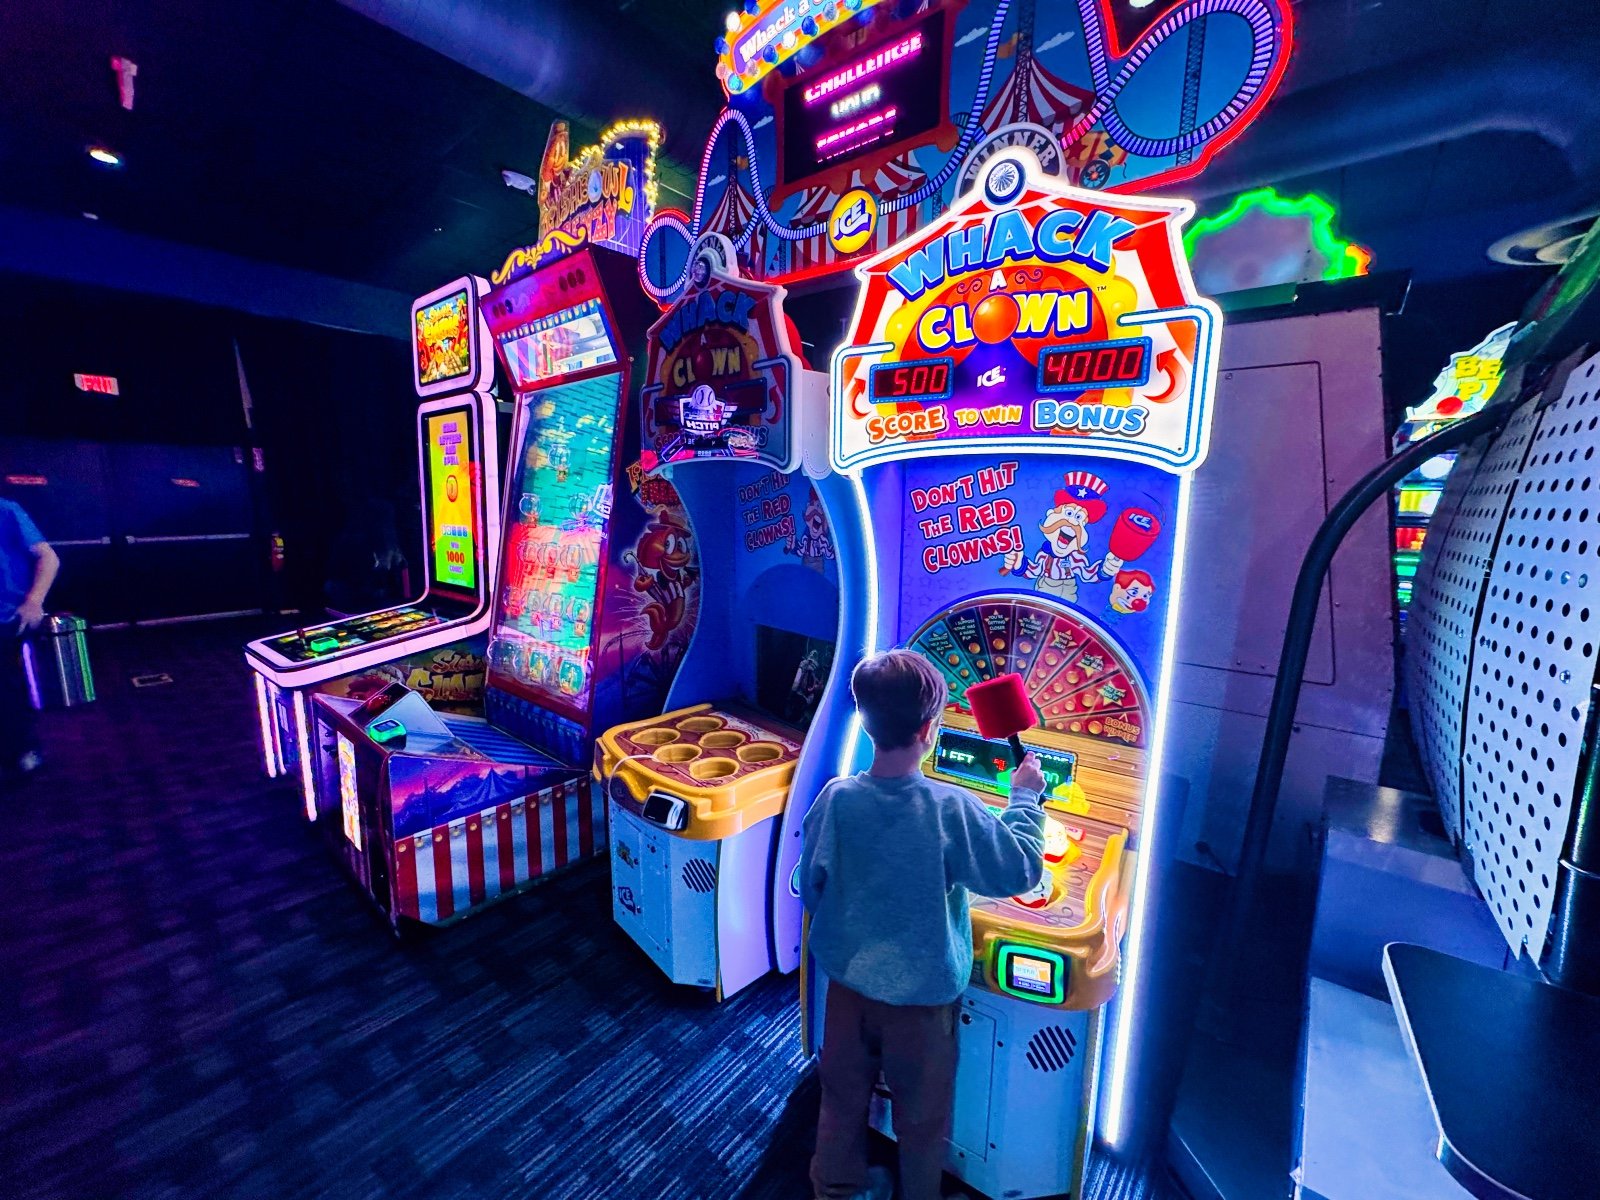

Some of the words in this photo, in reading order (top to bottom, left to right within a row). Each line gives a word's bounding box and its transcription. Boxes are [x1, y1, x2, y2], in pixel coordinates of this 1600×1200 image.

[740, 6, 796, 63] Whack
[966, 131, 1056, 180] WINNER
[834, 199, 870, 239] ICE
[887, 208, 1137, 300] WHACK
[990, 269, 1007, 291] A
[659, 291, 758, 351] WHACK
[918, 289, 1092, 353] CLOWN
[700, 333, 706, 346] A
[893, 364, 949, 396] 500
[977, 365, 1005, 387] ICE
[1048, 347, 1143, 383] 4000
[868, 405, 947, 442] SCORE
[956, 408, 976, 425] TO
[982, 405, 1023, 425] WIN
[1036, 400, 1149, 435] BONUS
[762, 494, 791, 520] RED
[911, 475, 974, 512] DON'T
[745, 515, 795, 551] CLOWNS!
[959, 499, 1015, 532] RED
[1129, 513, 1151, 531] ICE
[446, 551, 465, 564] 1000
[923, 526, 1024, 573] CLOWNS!
[1105, 716, 1141, 735] BONUS
